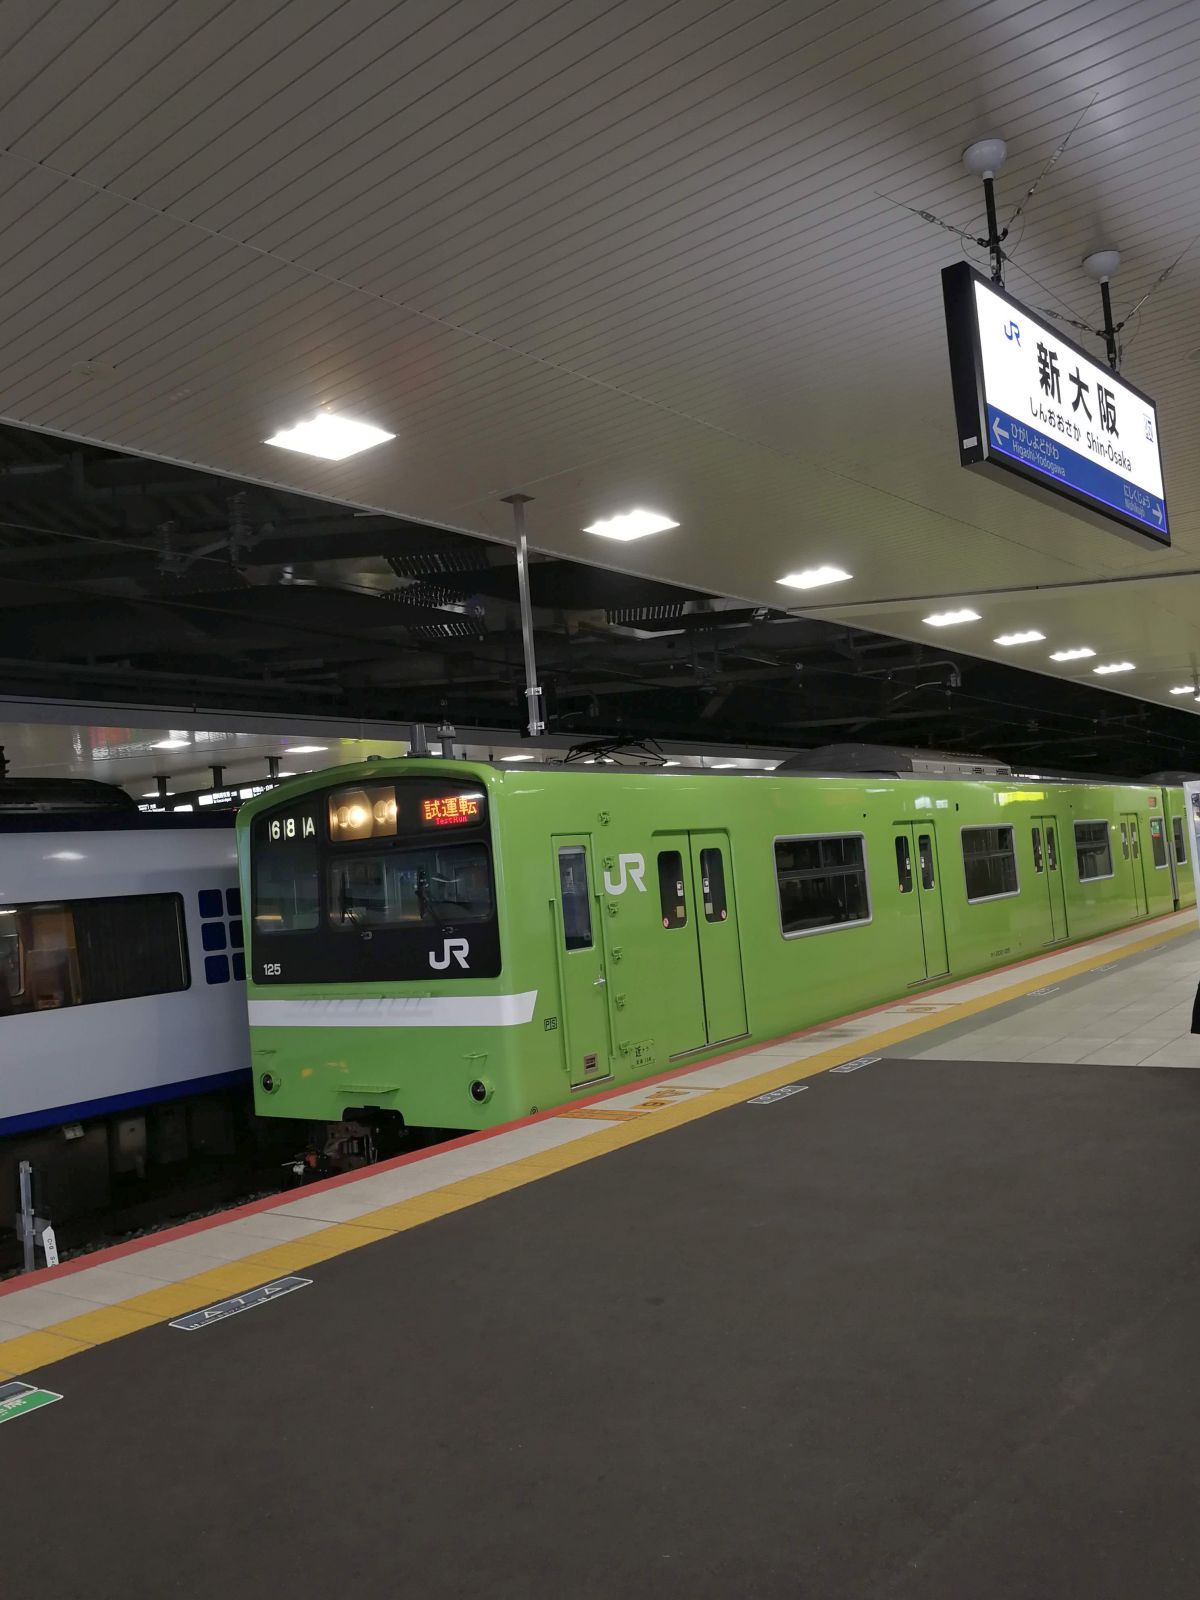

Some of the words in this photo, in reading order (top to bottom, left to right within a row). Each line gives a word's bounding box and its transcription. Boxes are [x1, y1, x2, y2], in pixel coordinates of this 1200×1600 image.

[1004, 320, 1021, 348] JR
[1036, 341, 1120, 439] 新大阪
[1030, 396, 1081, 442] しんおおさか
[424, 797, 478, 820] 試運転
[603, 852, 648, 896] JR
[263, 963, 282, 976] 125
[428, 937, 470, 970] JR
